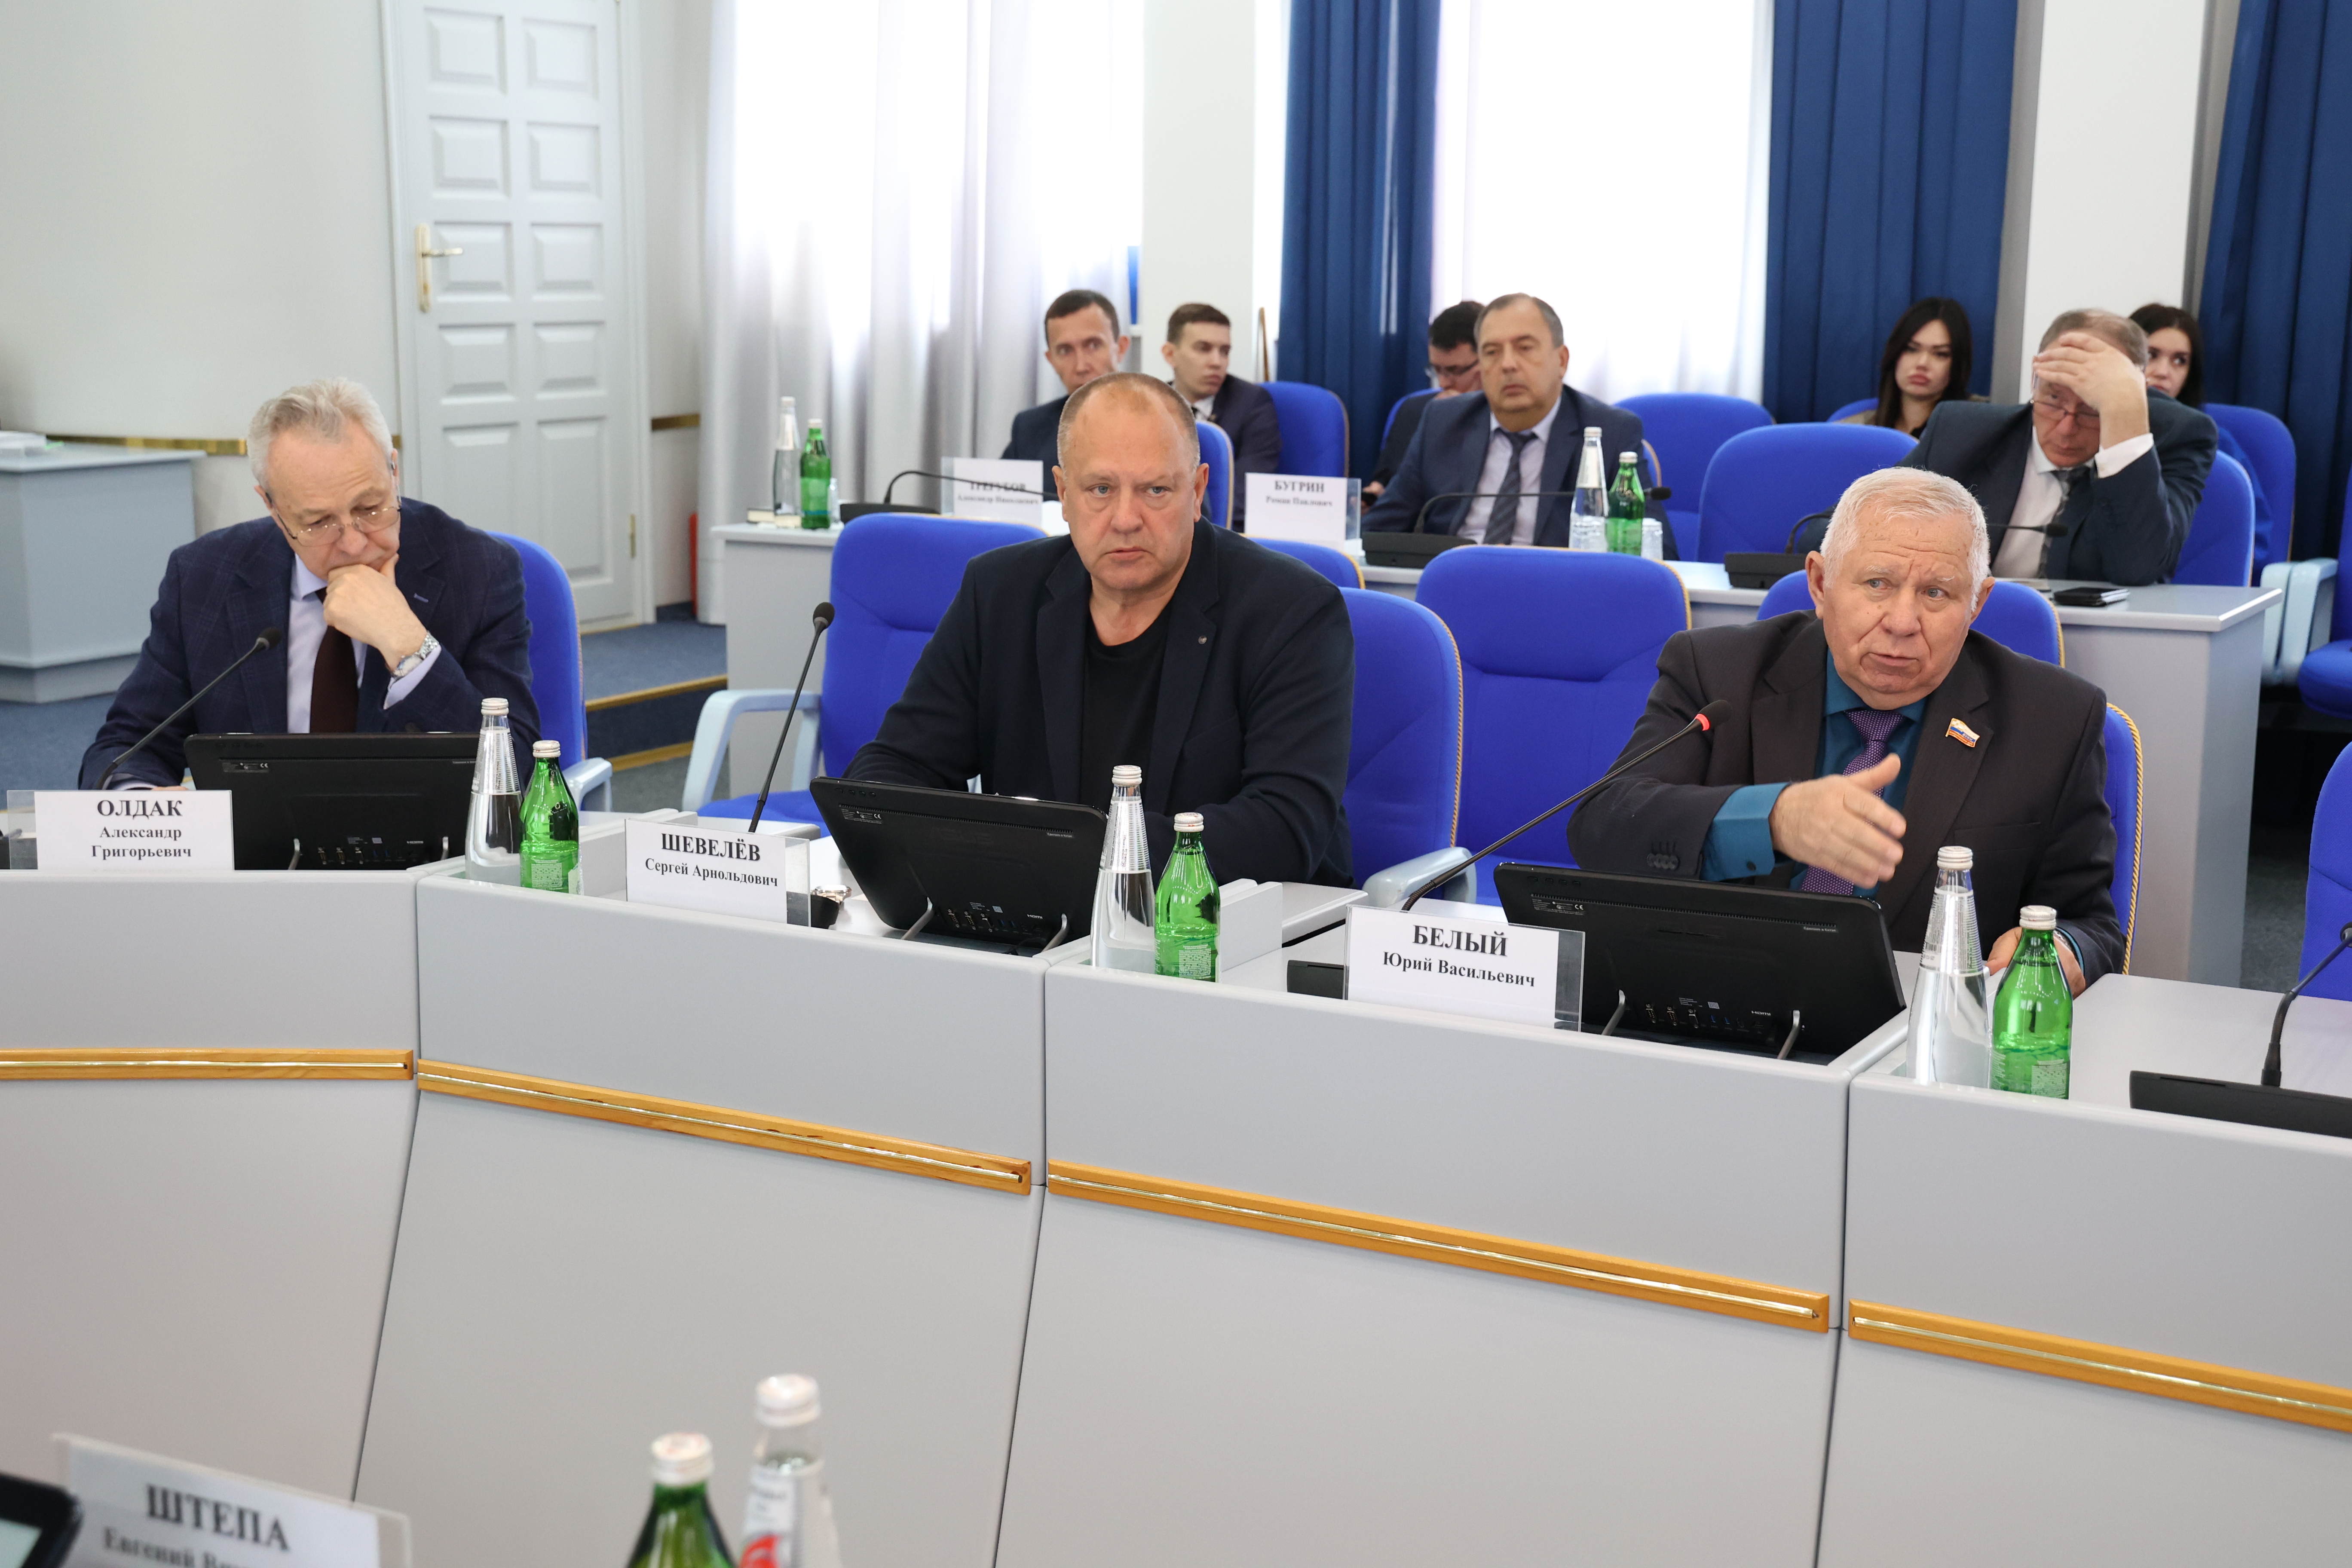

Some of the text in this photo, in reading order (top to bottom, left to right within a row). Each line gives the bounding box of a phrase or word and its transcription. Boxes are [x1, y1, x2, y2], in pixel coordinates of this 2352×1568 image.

[1275, 481, 1325, 493] БУГРИН
[98, 800, 183, 819] ОЛДАК
[100, 827, 182, 841] Александр
[662, 833, 761, 861] ШЕВЕЛЁВ
[92, 845, 192, 861] Григорьевич
[645, 858, 778, 887] Сергей Арнольдович
[1412, 925, 1508, 957] БЕЛЫЙ
[1383, 951, 1535, 987] Юрий Васильевич
[146, 1484, 289, 1551] ШТЕПА
